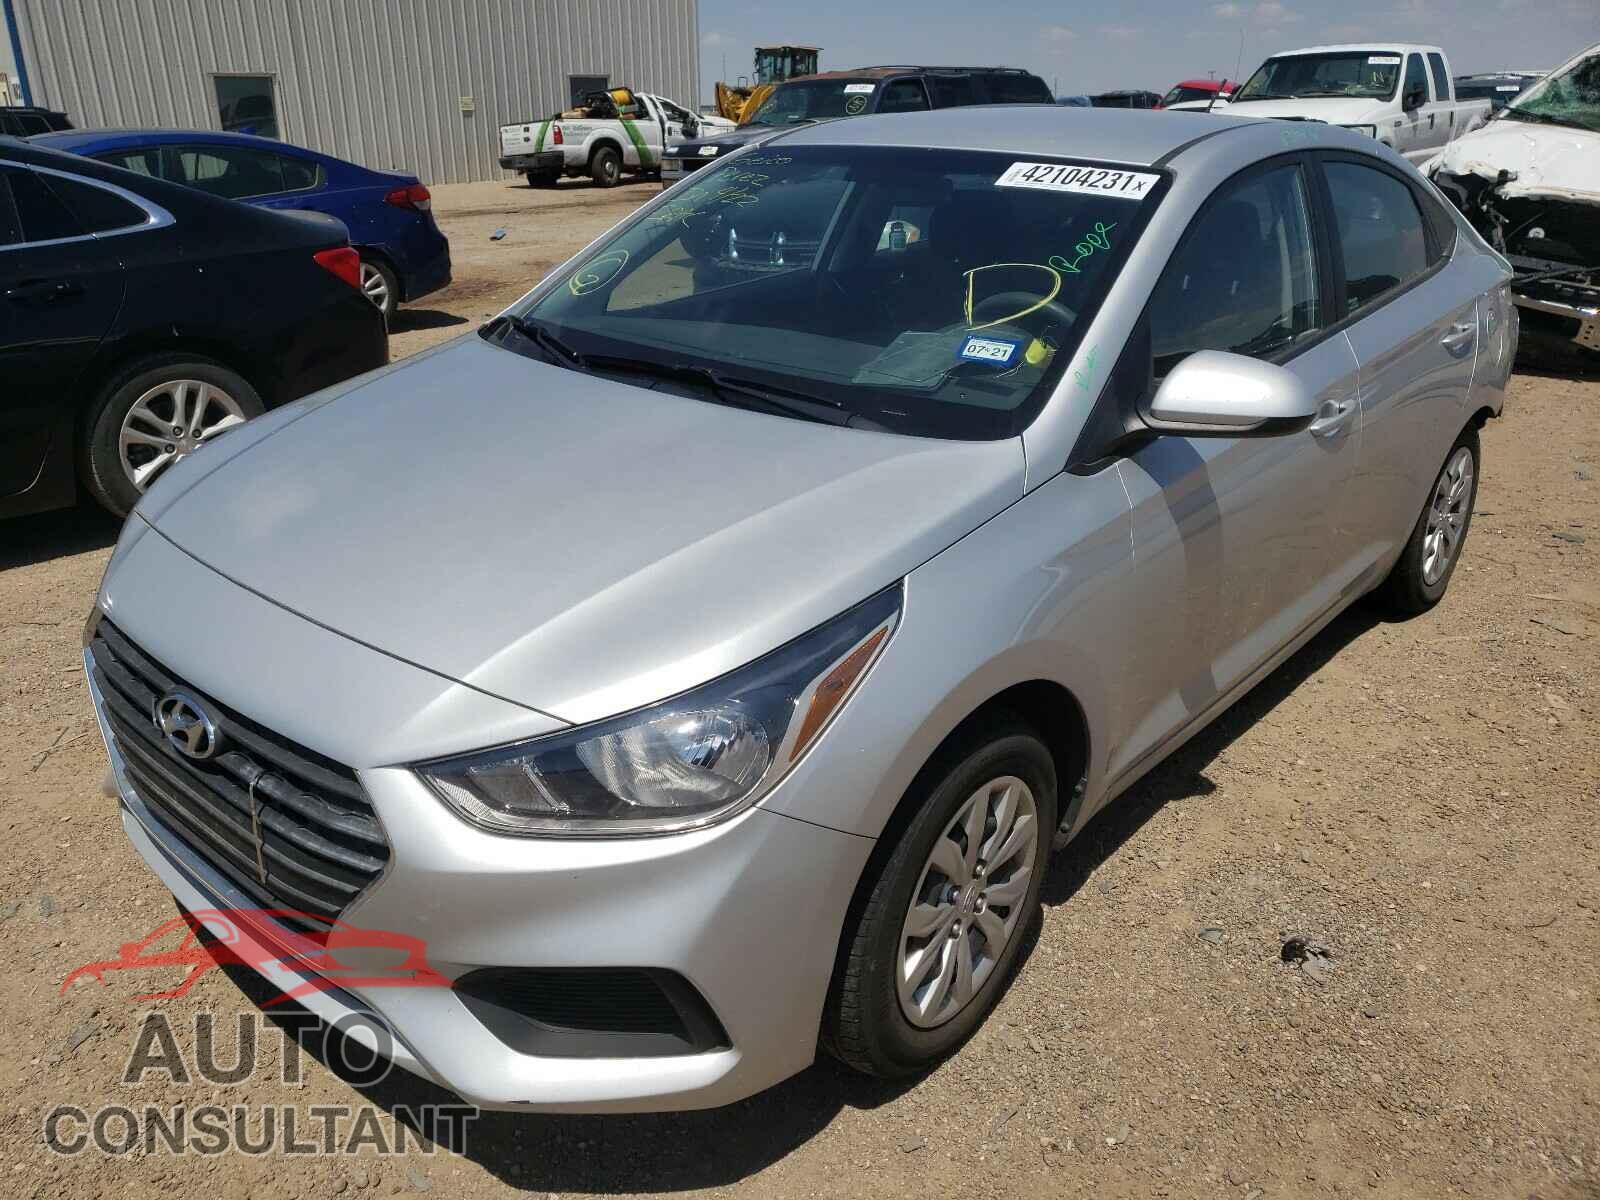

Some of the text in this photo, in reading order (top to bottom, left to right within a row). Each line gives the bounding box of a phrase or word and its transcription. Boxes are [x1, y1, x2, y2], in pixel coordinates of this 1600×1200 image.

[1020, 165, 1136, 192] 42104231
[967, 344, 1008, 358] 07 21
